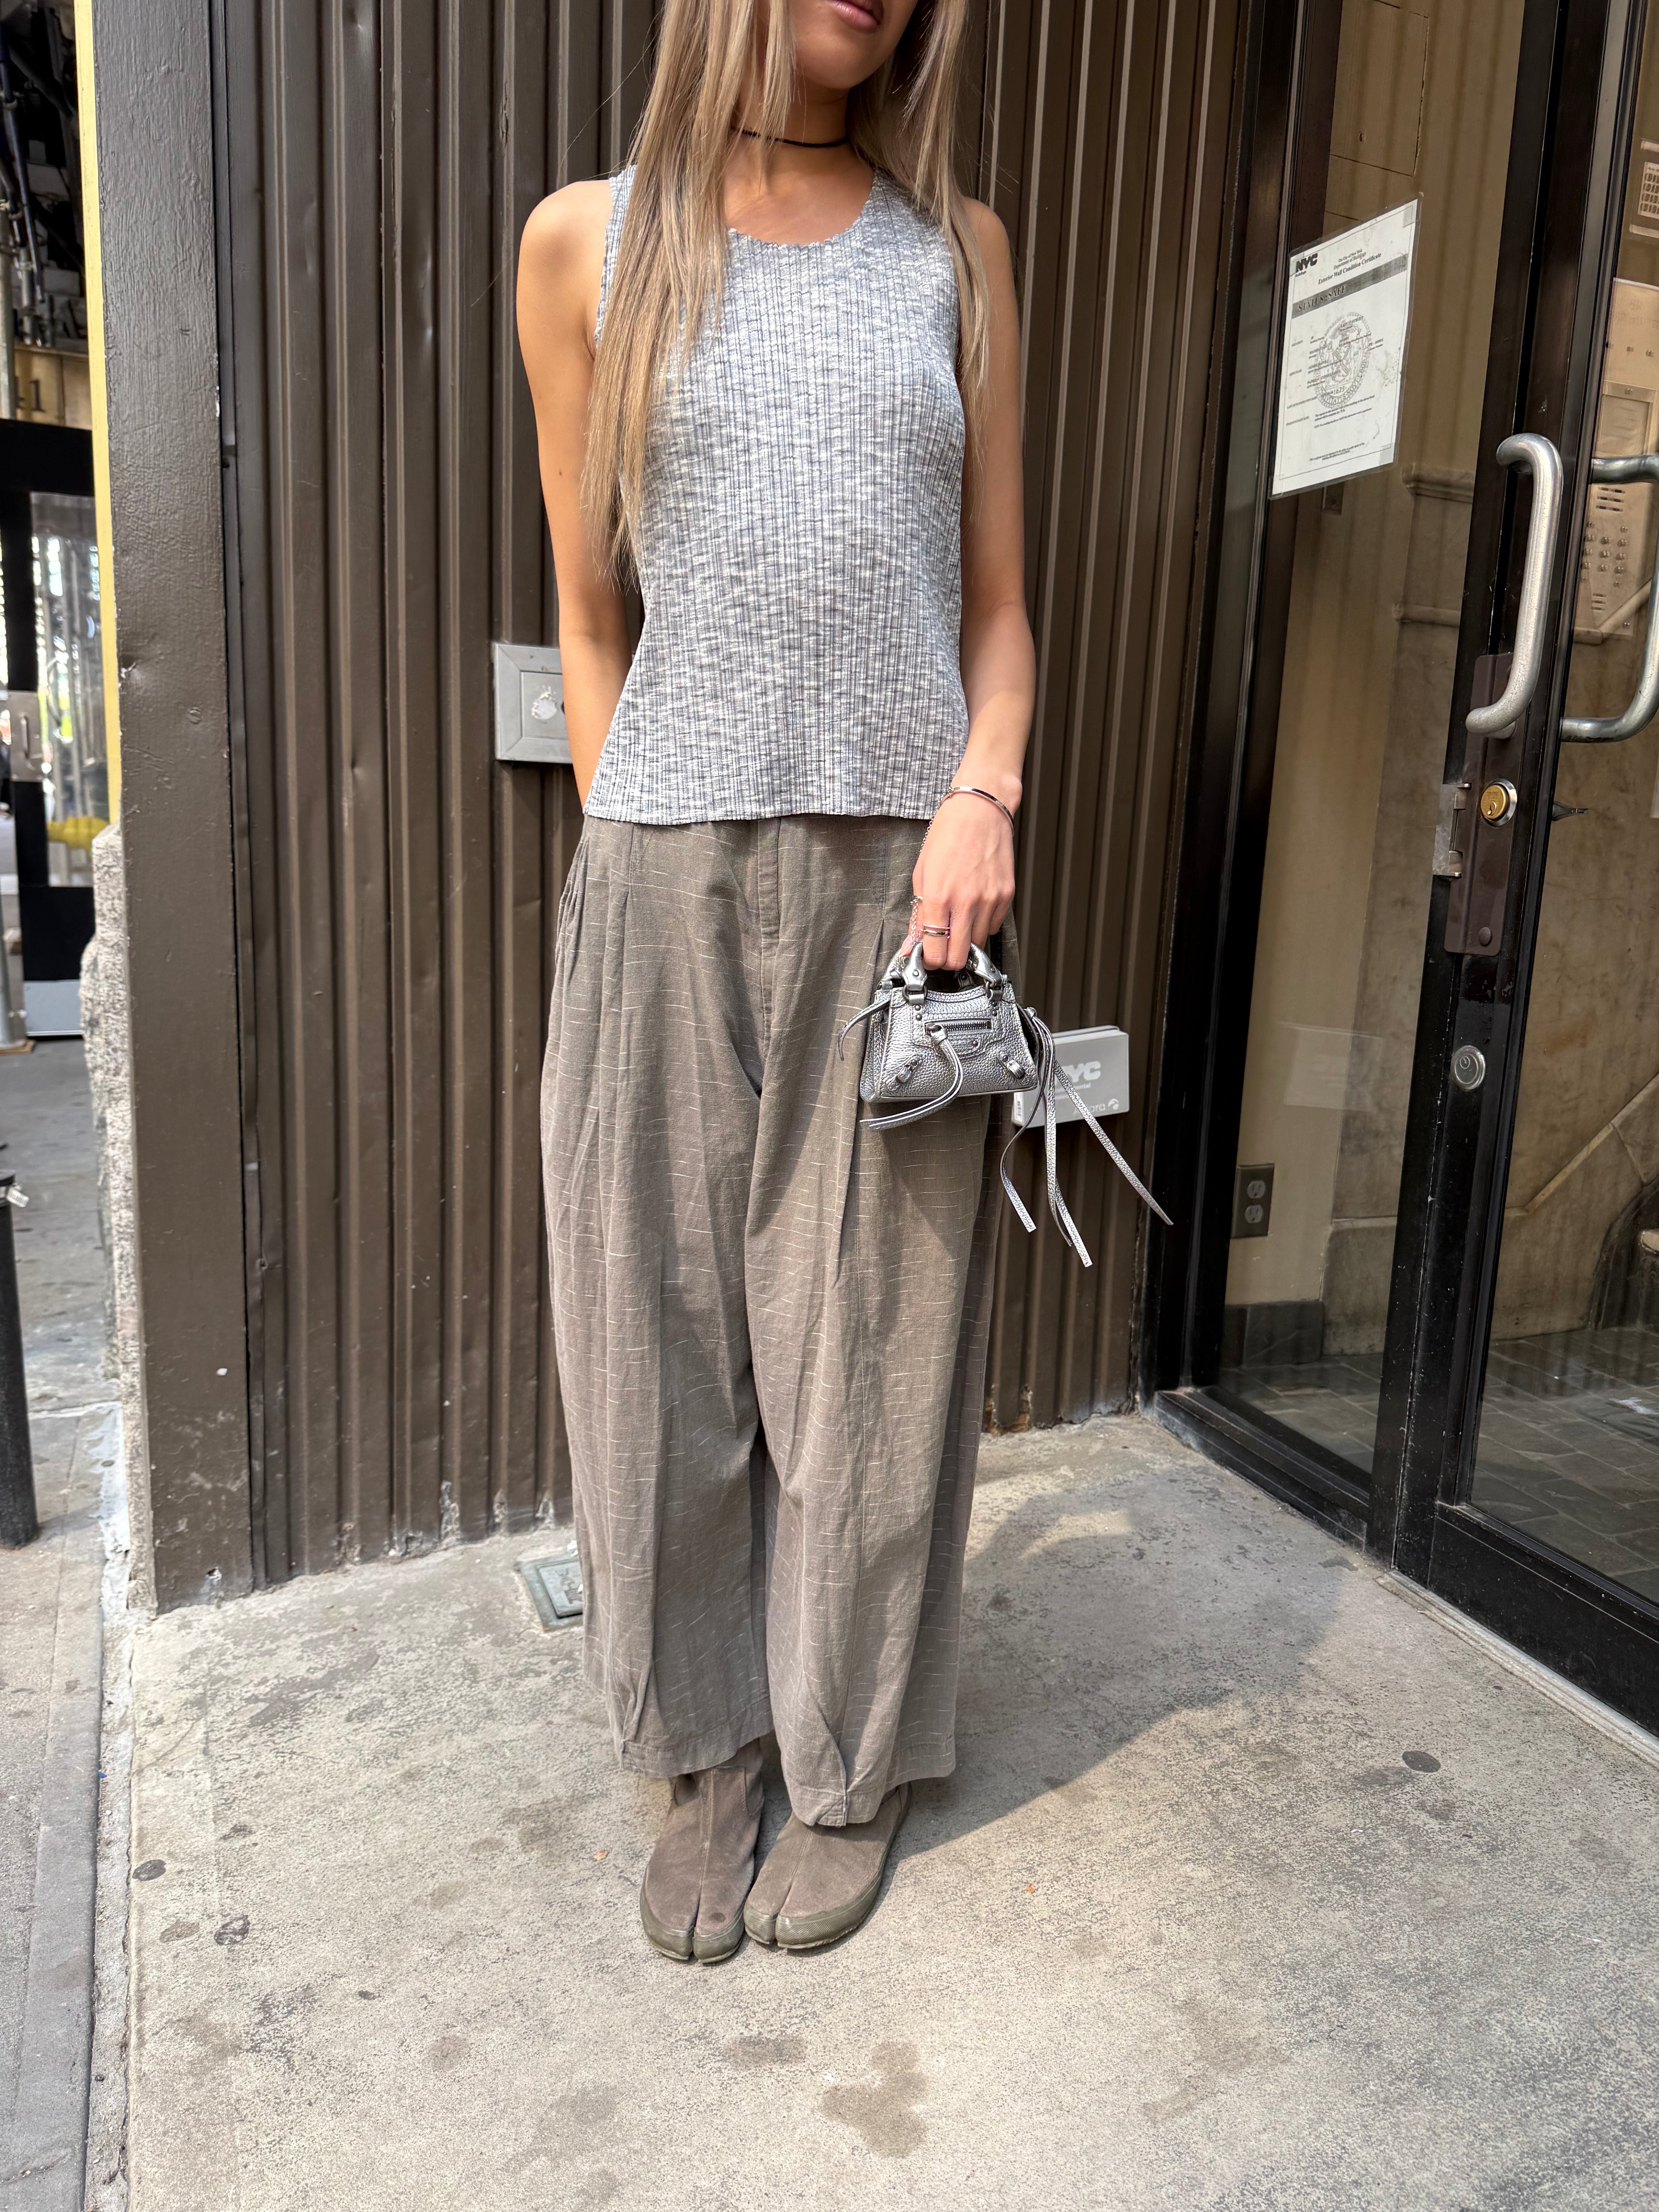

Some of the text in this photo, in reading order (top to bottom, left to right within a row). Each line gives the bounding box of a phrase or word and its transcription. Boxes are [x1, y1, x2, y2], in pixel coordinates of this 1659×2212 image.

[1296, 253, 1317, 273] NYC
[1318, 252, 1381, 285] Exterior Wall Condition Certificate
[1328, 284, 1347, 299] SAFE
[1073, 1104, 1106, 1115] Aara
